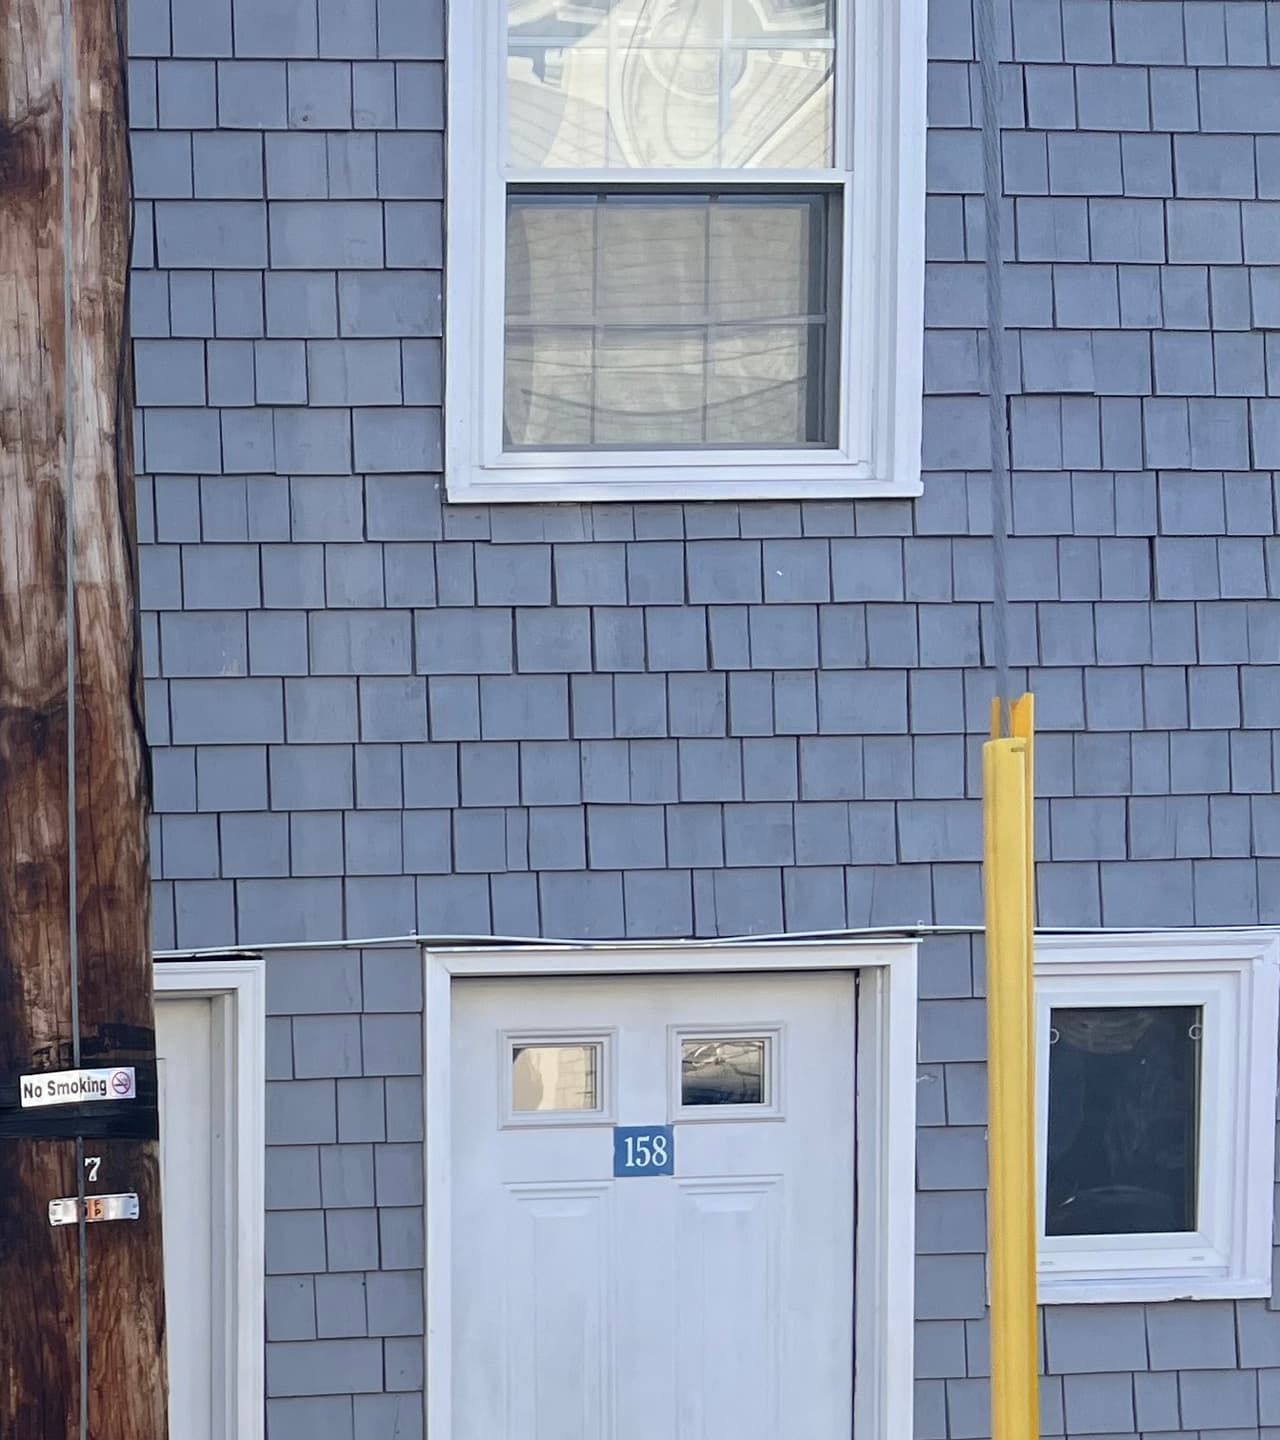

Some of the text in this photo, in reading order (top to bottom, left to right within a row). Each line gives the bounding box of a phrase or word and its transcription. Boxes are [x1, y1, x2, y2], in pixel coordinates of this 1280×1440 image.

[23, 1076, 108, 1100] No Smoking
[624, 1135, 667, 1167] 158
[84, 1157, 101, 1182] 7
